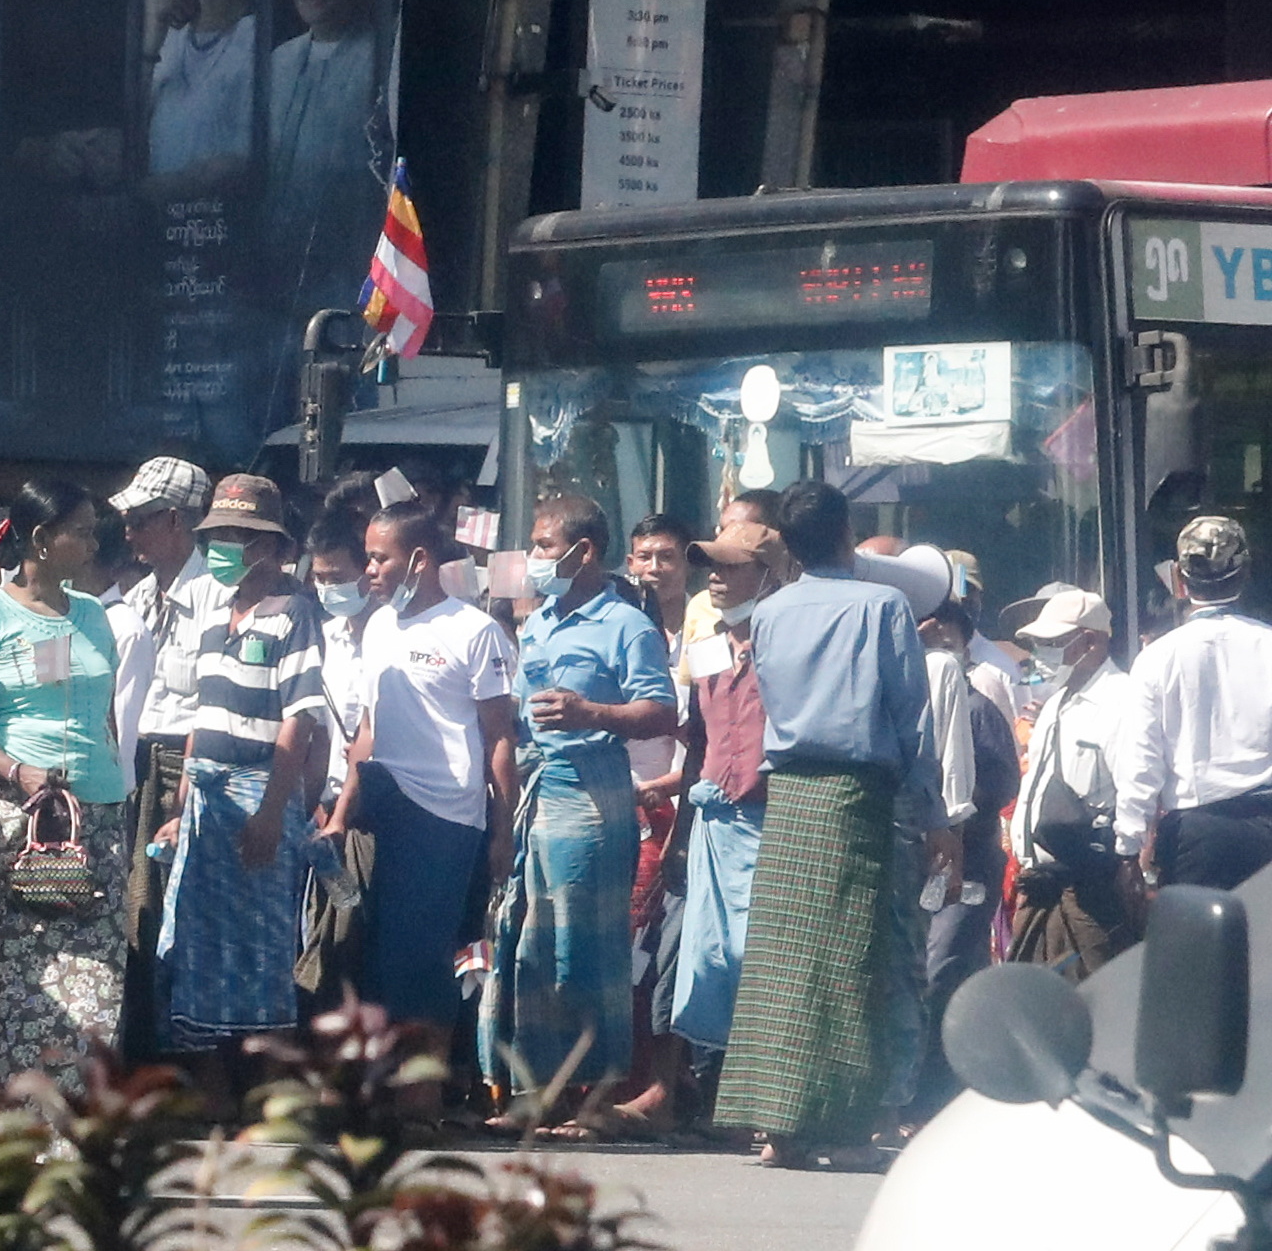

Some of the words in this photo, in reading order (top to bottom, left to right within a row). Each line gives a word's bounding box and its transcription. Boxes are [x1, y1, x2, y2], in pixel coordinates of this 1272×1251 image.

[614, 75, 648, 89] Ticket
[651, 77, 685, 91] Prices
[212, 498, 258, 511] adidas
